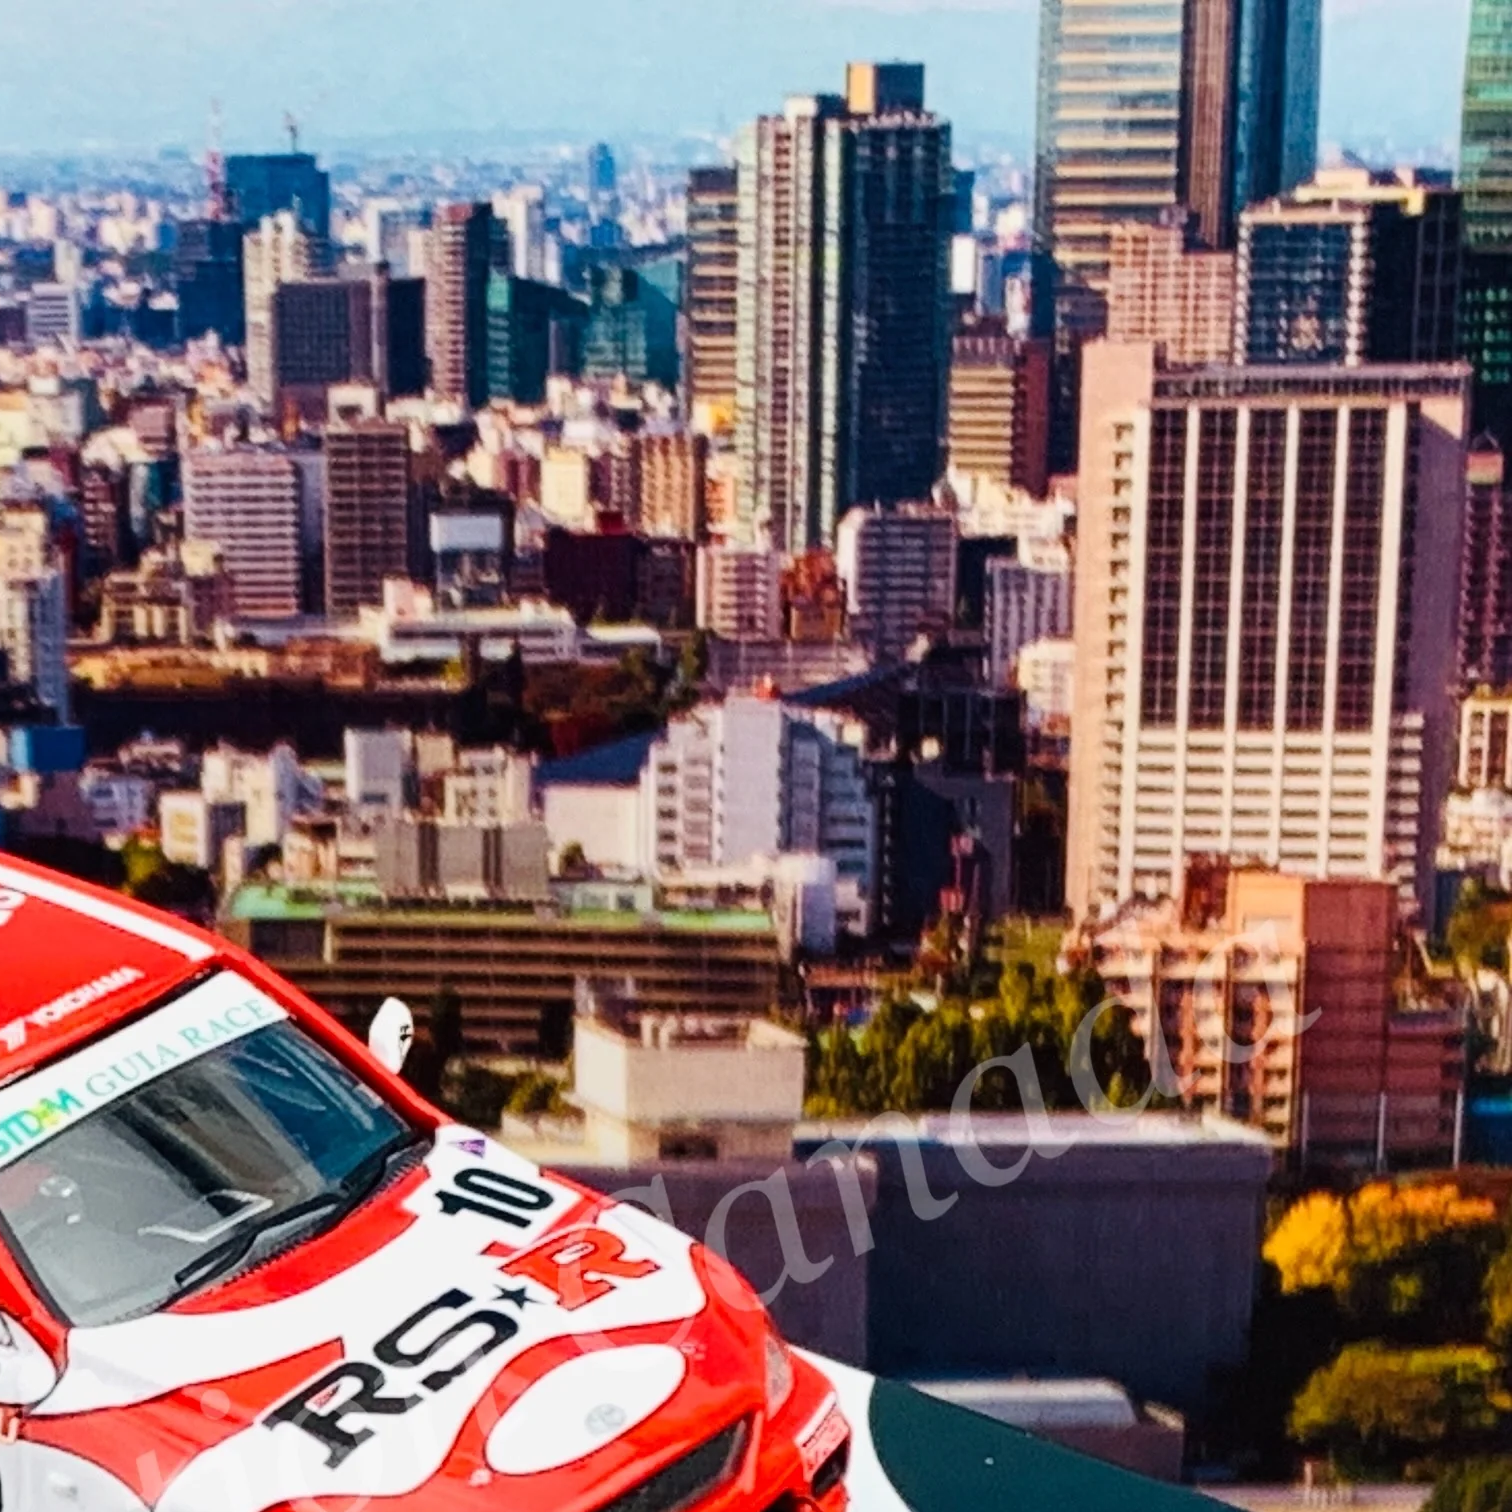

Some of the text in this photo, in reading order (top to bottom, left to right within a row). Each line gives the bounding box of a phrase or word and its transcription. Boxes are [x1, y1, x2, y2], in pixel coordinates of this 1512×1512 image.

[85, 1041, 178, 1100] GUIA
[184, 997, 275, 1049] RACE
[433, 1166, 556, 1230] 10
